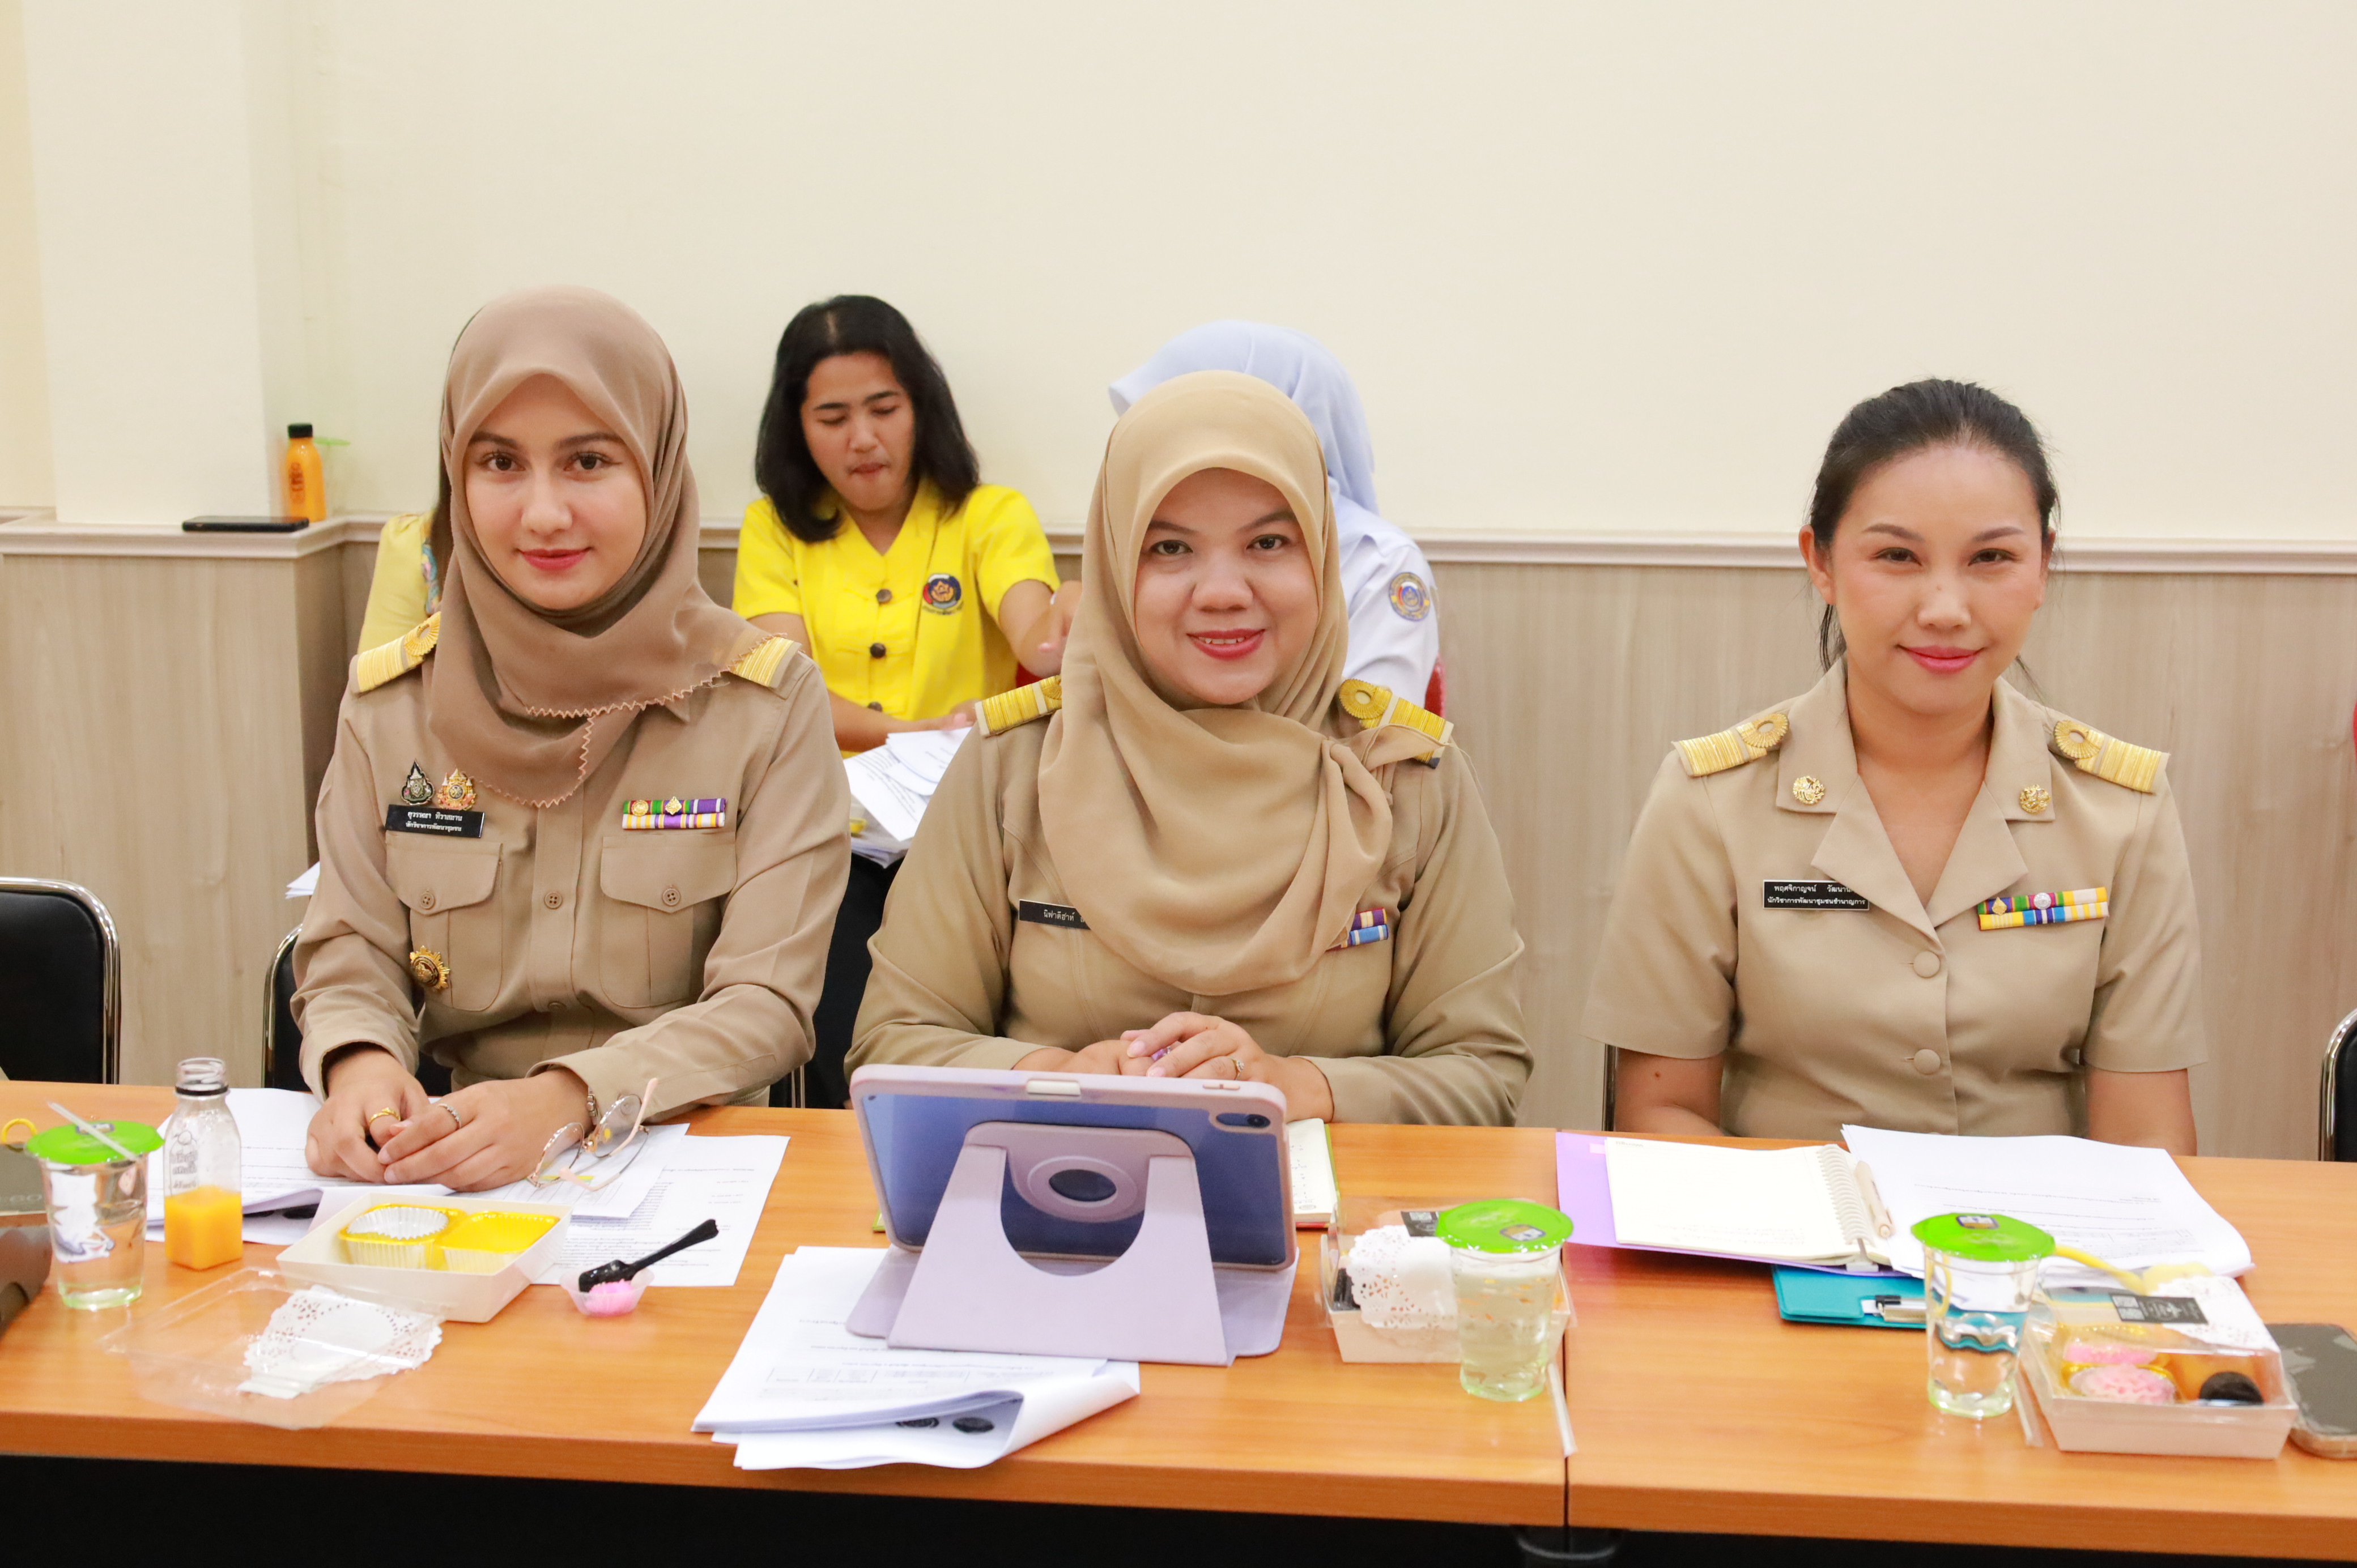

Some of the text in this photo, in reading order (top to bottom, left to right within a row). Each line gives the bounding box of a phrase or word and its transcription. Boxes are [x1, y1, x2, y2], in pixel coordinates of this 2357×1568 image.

[1767, 896, 1866, 906] นักวิชาการพัฒนาชุมชนชำนาญการ
